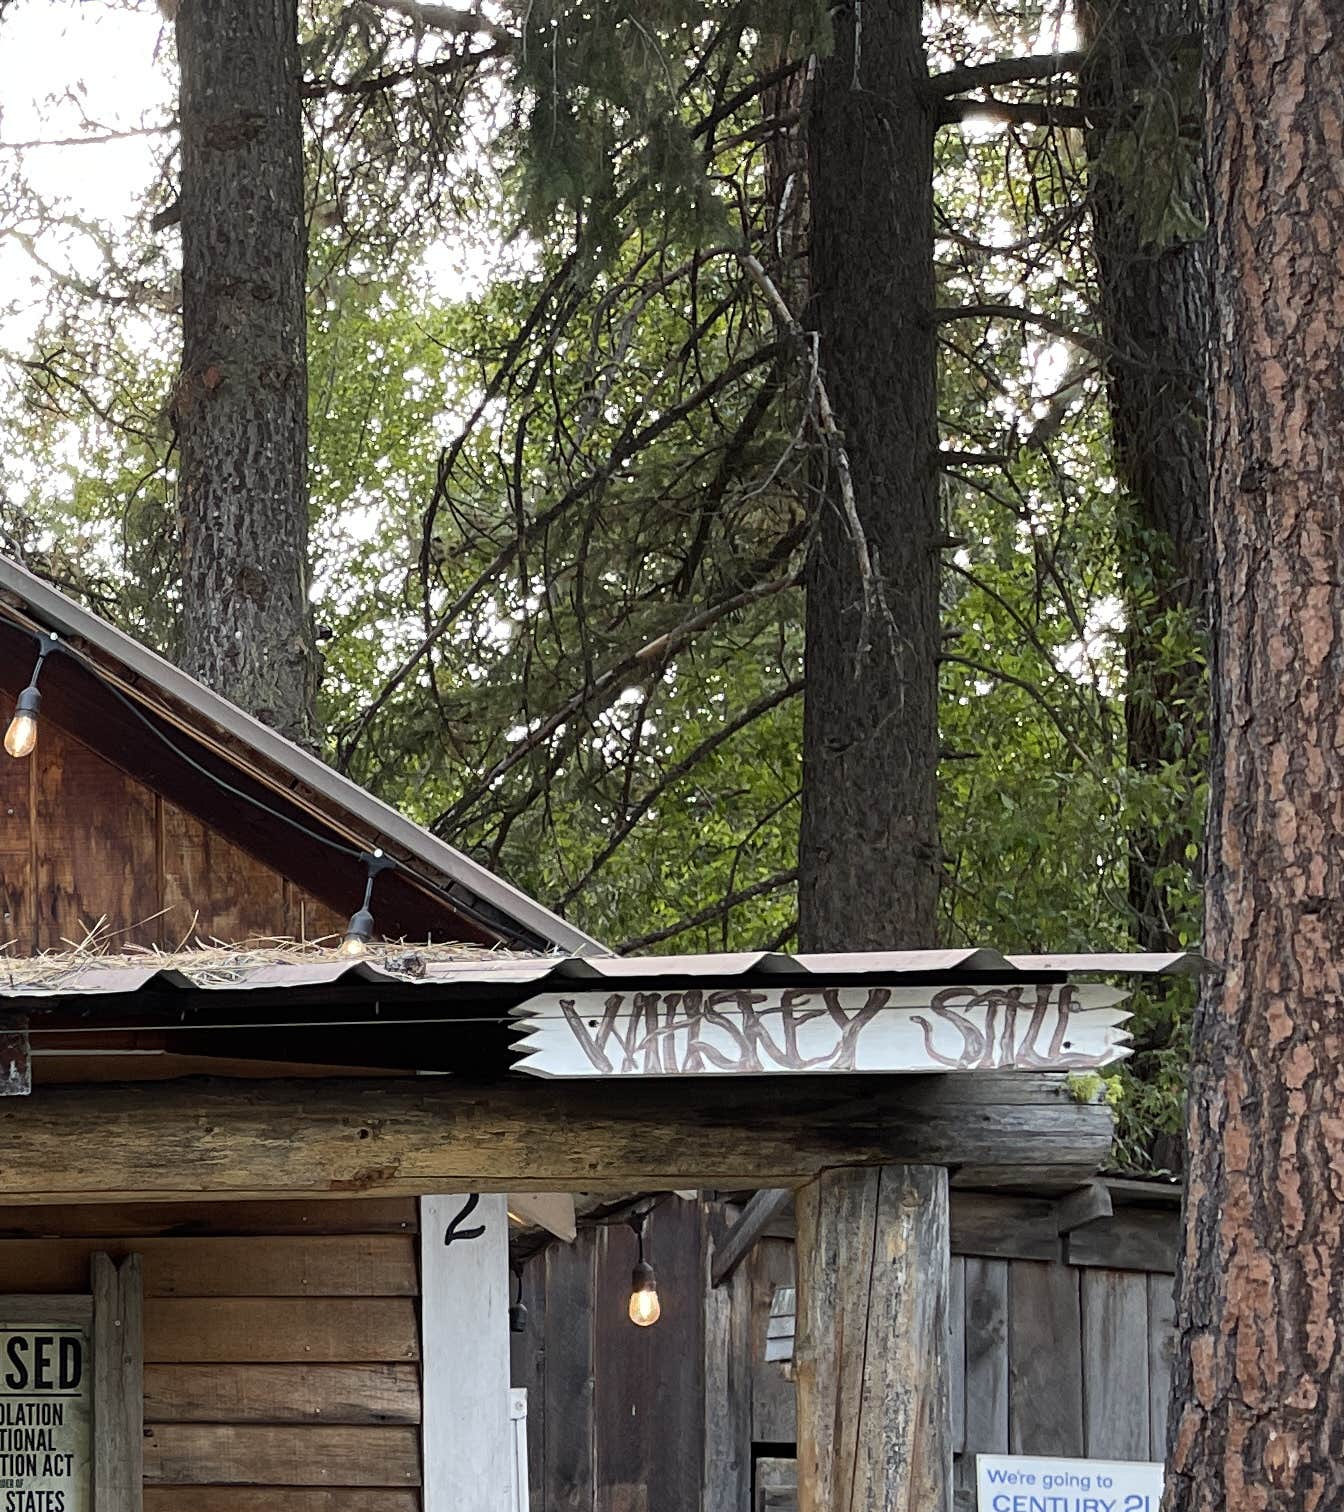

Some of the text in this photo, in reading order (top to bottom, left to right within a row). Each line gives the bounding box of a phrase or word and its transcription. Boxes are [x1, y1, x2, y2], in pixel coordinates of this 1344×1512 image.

[559, 984, 1117, 1073] WHISKEY STILL
[444, 1193, 486, 1246] 2
[42, 1453, 74, 1478] ACT
[15, 1478, 24, 1489] OF
[987, 1469, 1114, 1492] We're going to
